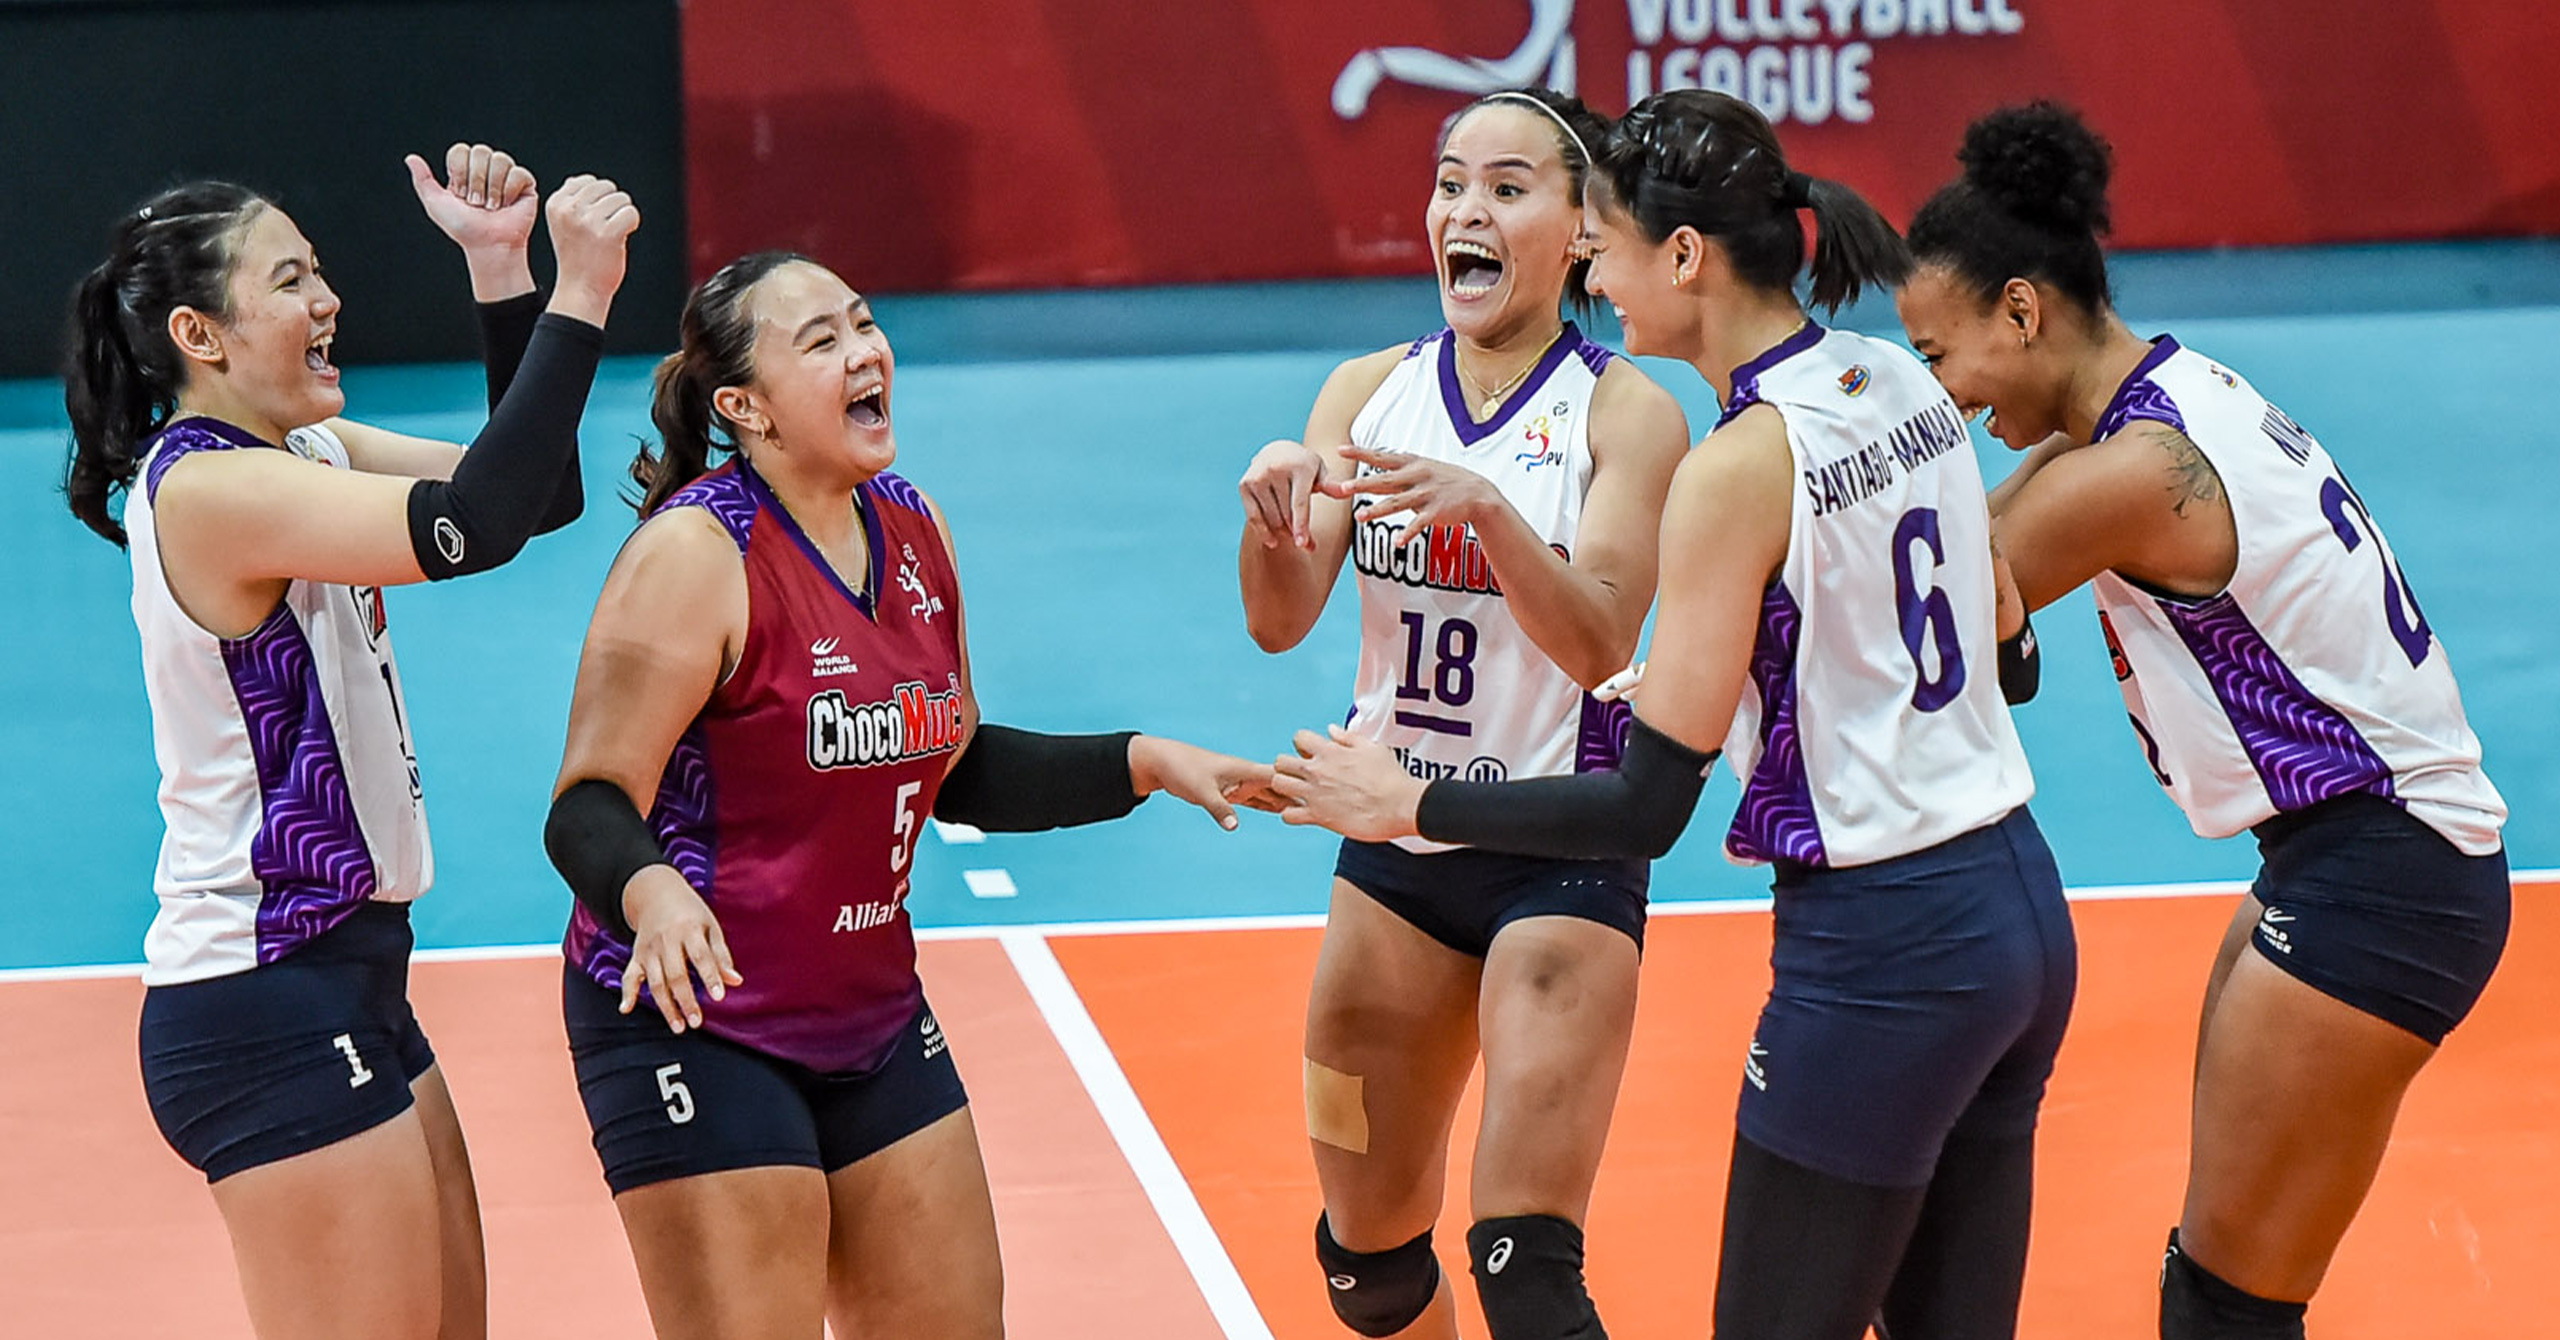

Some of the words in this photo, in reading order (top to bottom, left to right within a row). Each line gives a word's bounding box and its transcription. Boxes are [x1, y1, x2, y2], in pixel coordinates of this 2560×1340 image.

[1626, 42, 1875, 125] LEAGUE
[1545, 451, 1565, 466] PV
[1891, 506, 1967, 713] 6
[812, 664, 858, 677] BALANCE
[814, 655, 850, 667] WORLD
[1395, 610, 1478, 707] 18
[890, 780, 922, 873] 5
[333, 1033, 374, 1089] 1
[655, 1063, 696, 1126] 5
